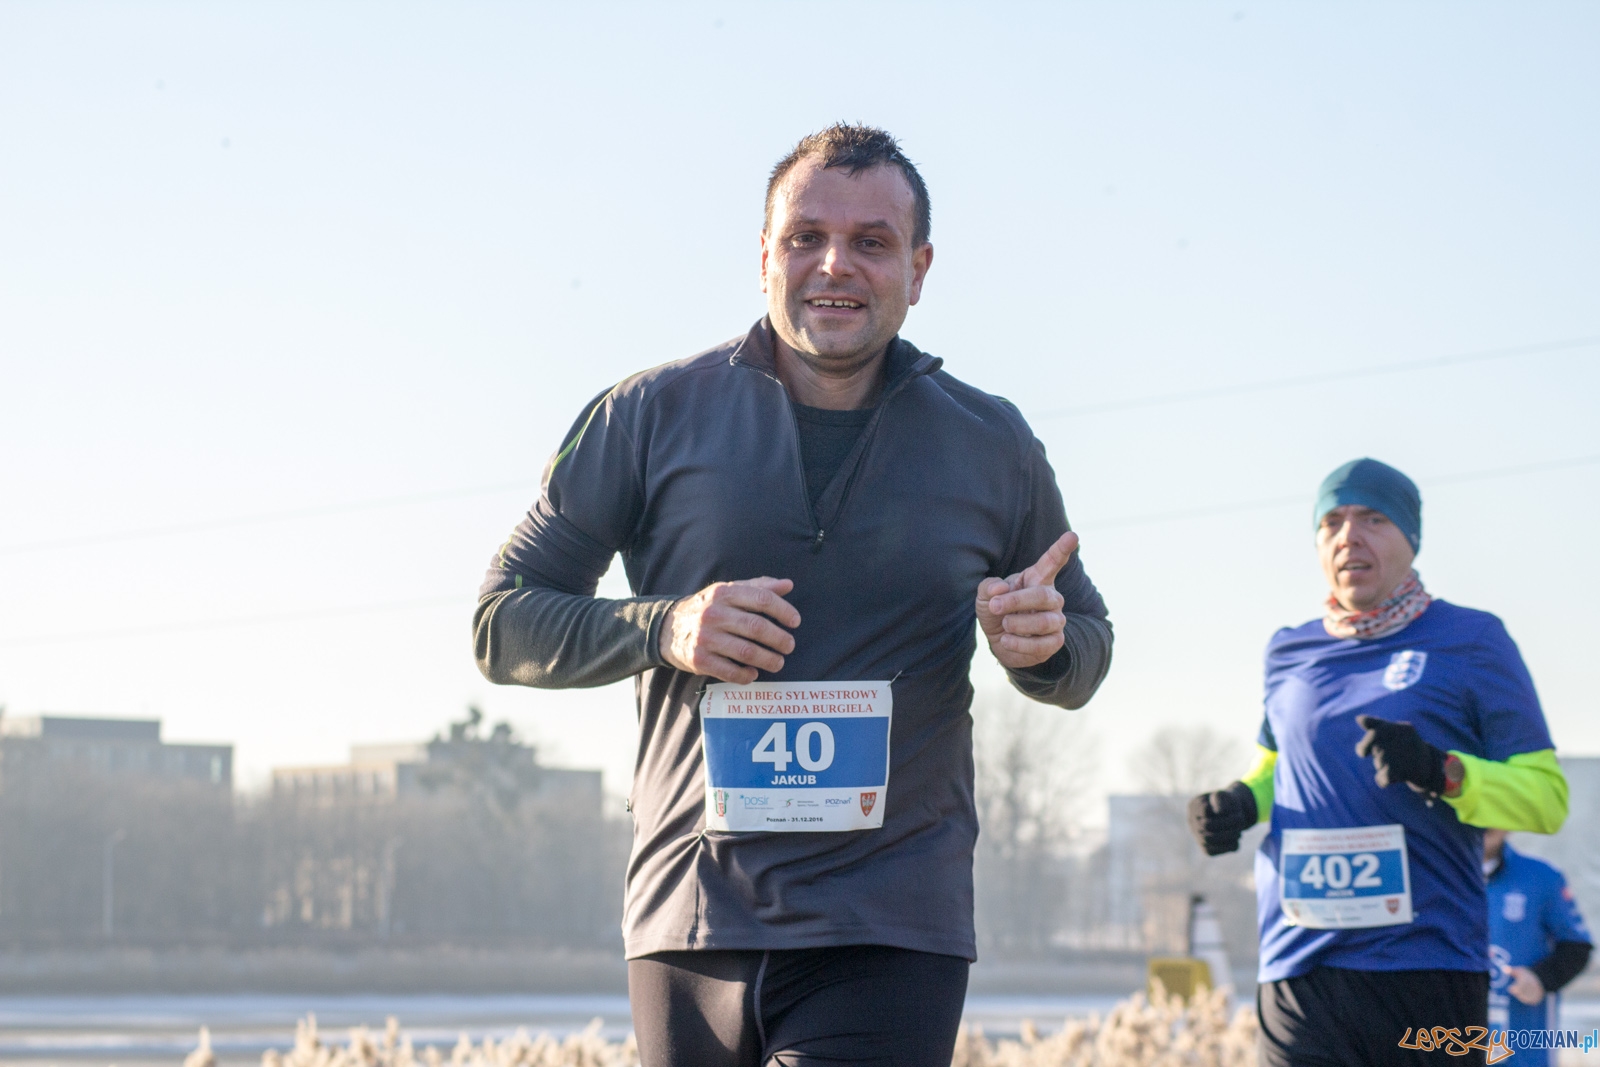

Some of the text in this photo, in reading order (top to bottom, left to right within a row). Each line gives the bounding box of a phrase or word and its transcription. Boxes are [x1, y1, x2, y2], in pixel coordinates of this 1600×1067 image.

[723, 689, 878, 701] XXXII BIEG SYLWESTROWY
[727, 703, 873, 715] IM. RYSZARDA BURGIELA
[751, 721, 835, 772] 40
[771, 775, 817, 785] JAKUB
[1299, 853, 1383, 890] 402
